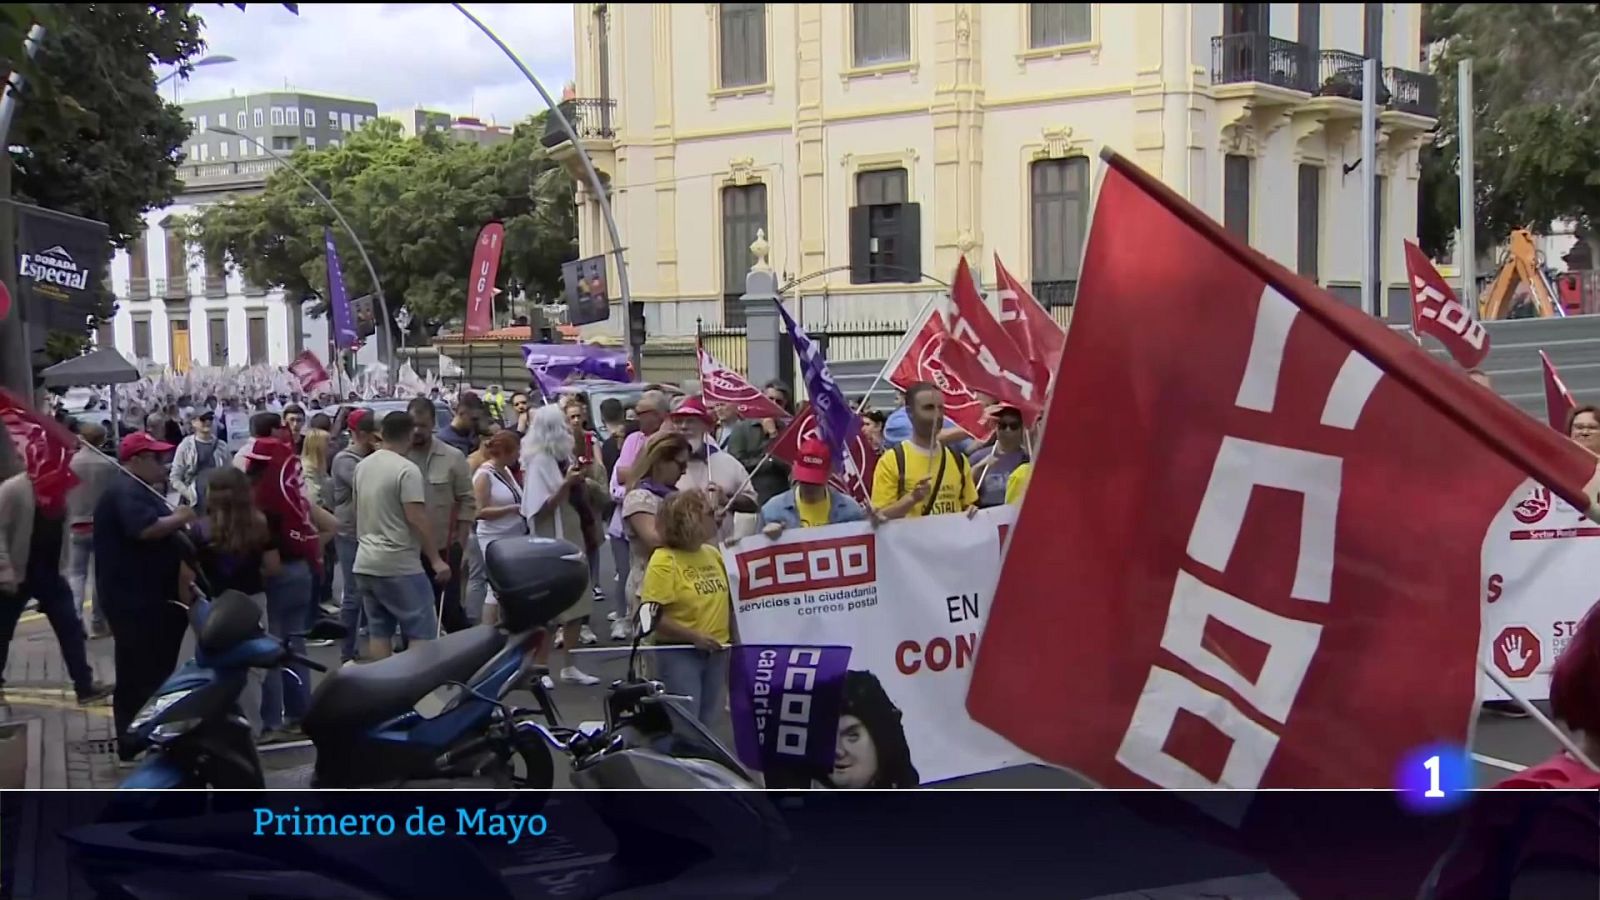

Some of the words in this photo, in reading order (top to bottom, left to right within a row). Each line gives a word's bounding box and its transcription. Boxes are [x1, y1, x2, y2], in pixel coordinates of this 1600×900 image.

[20, 254, 88, 290] Especial
[35, 254, 77, 271] DORADA
[477, 260, 490, 312] UGT
[747, 544, 869, 591] CCOO
[739, 599, 791, 613] servicios
[793, 597, 801, 606] a
[804, 593, 815, 604] la
[797, 604, 845, 616] correos
[848, 596, 879, 612] postal
[946, 593, 979, 623] EN
[1553, 621, 1577, 637] ST
[895, 632, 980, 675] CON
[776, 647, 822, 756] CCOO
